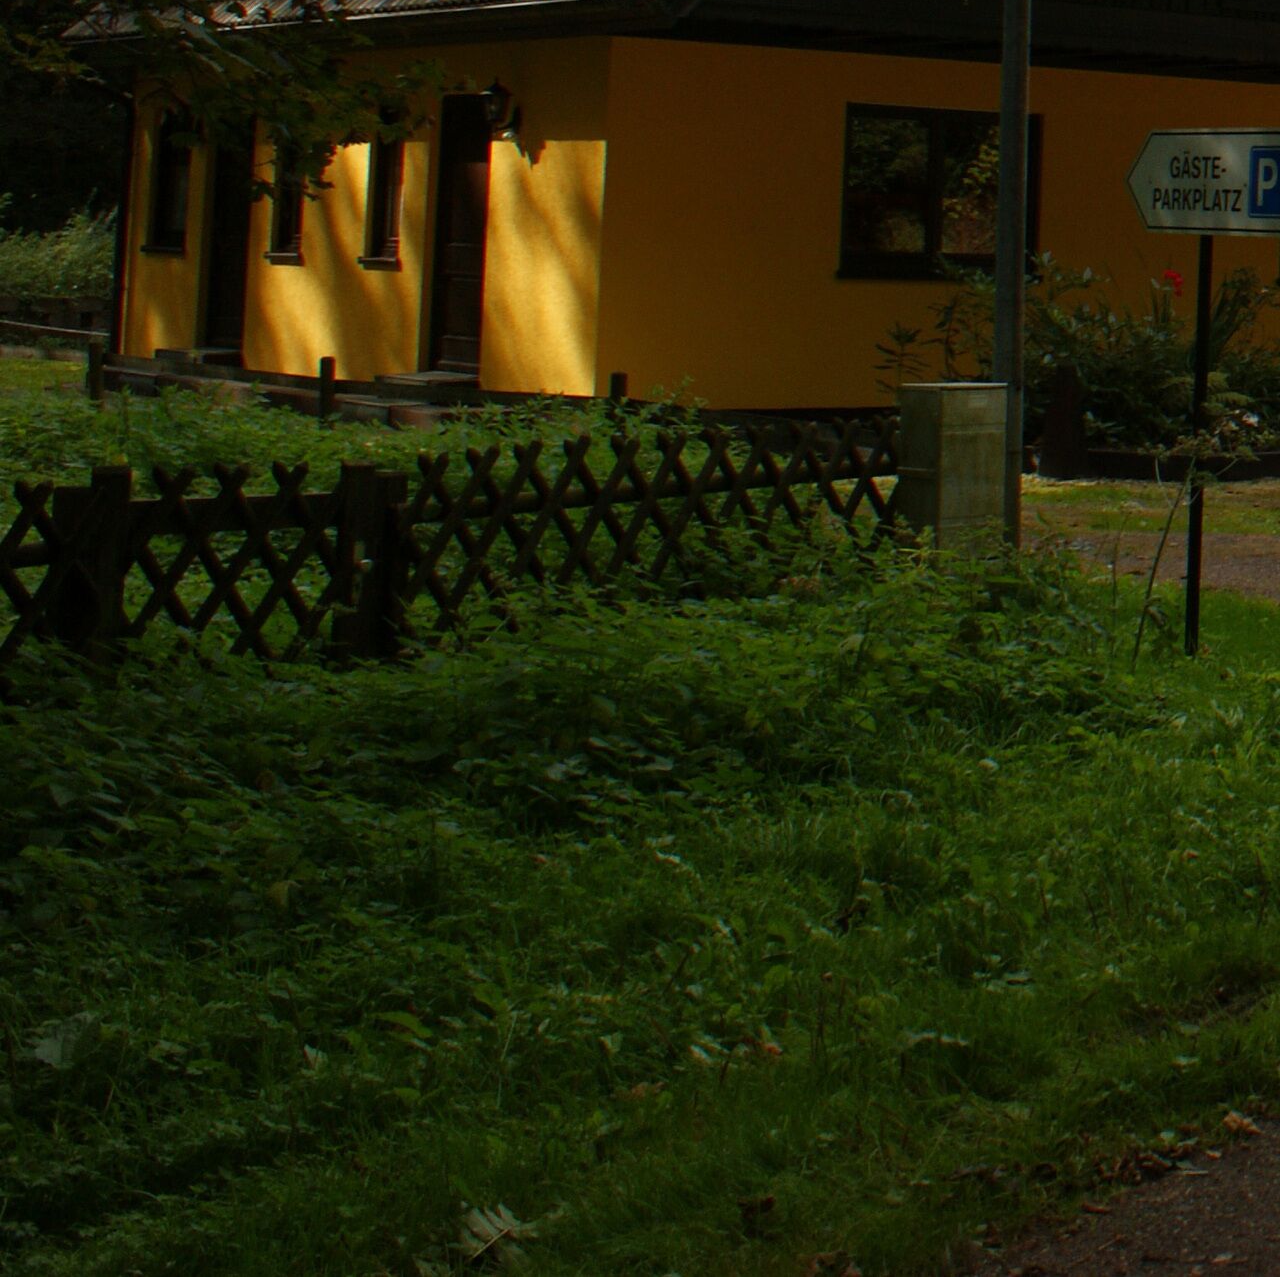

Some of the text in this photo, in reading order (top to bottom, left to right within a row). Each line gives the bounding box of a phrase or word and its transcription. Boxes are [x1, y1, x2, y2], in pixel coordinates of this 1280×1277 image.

[1170, 151, 1227, 179] GÄSTE-
[1256, 157, 1279, 207] P
[1152, 187, 1242, 212] PARKPLATZ
